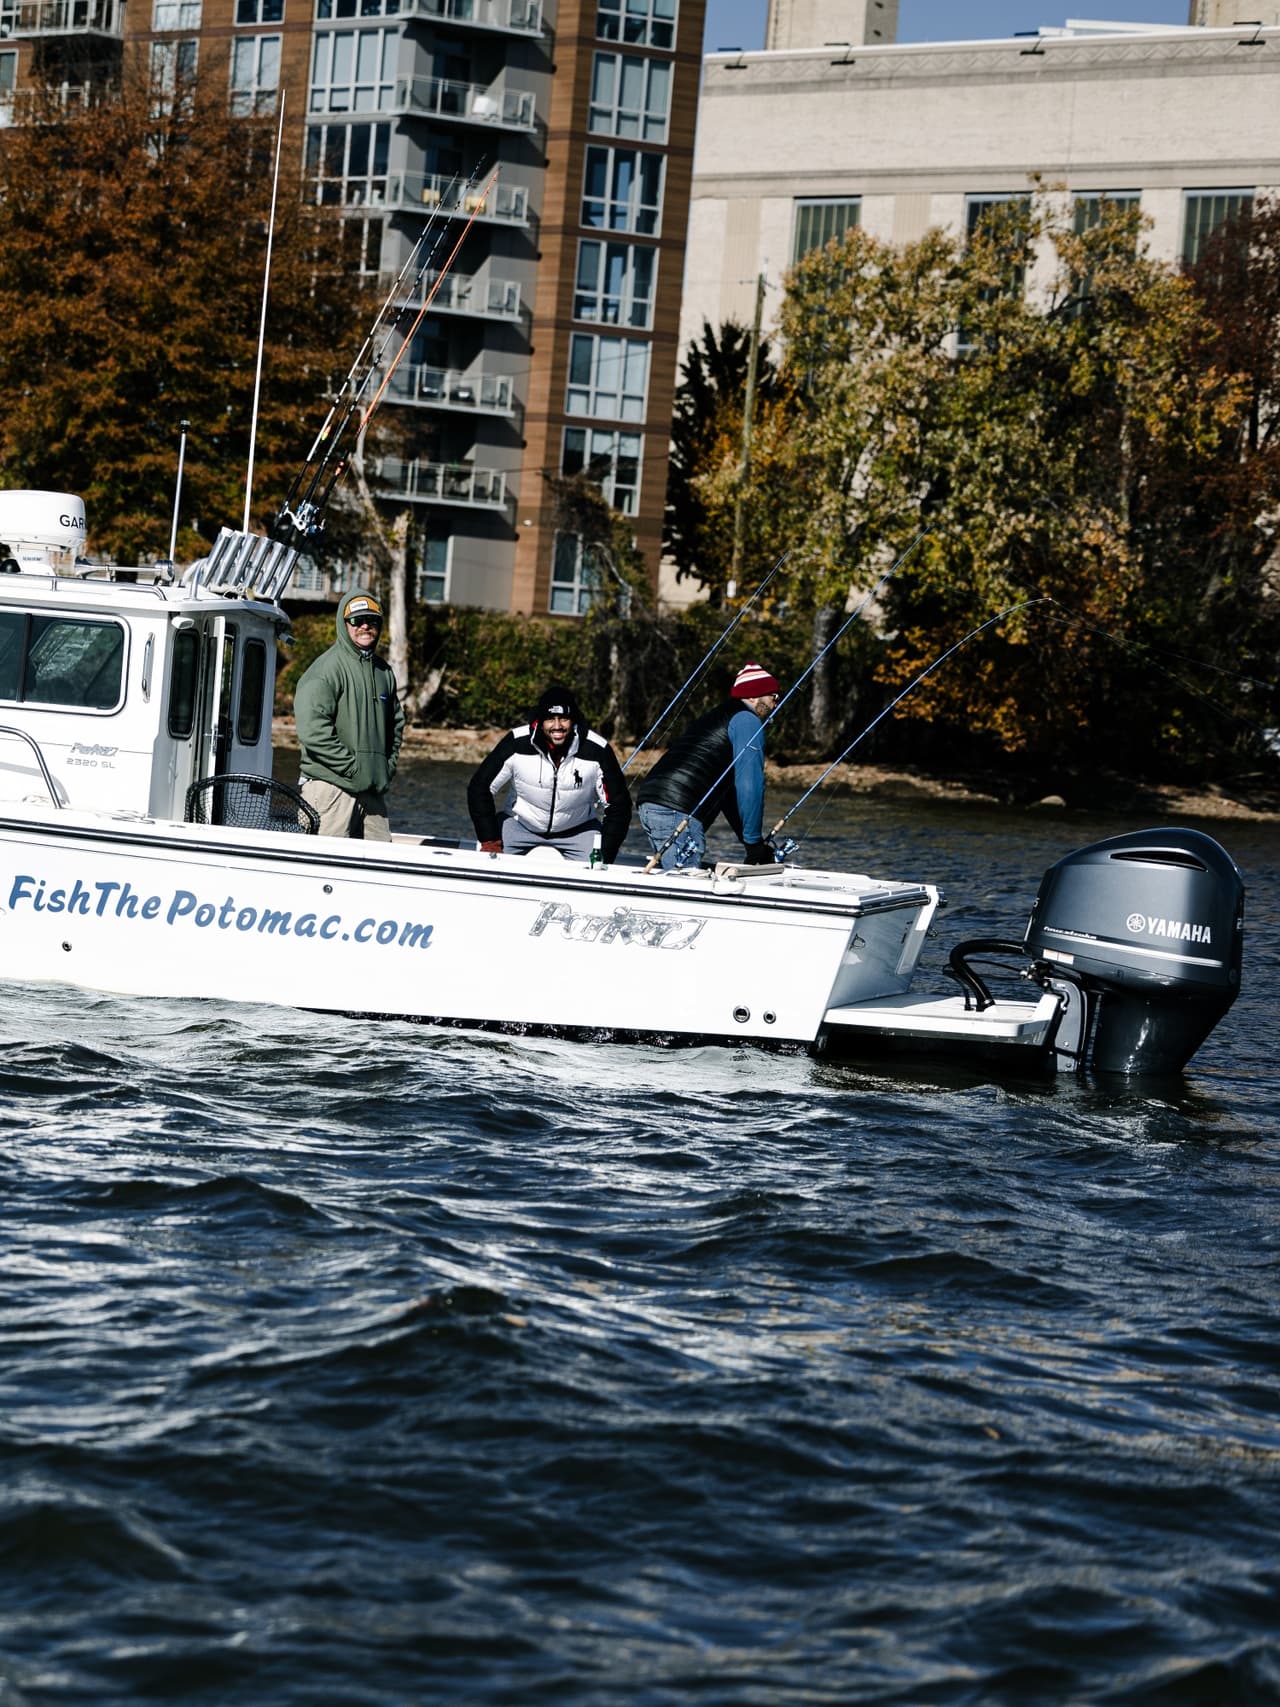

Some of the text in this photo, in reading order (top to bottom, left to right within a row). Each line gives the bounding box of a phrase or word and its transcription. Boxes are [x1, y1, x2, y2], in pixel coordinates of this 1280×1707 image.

[66, 757, 116, 769] 2320 SL
[8, 875, 434, 949] FishThePotomac.com
[1147, 917, 1212, 944] YAMAHA
